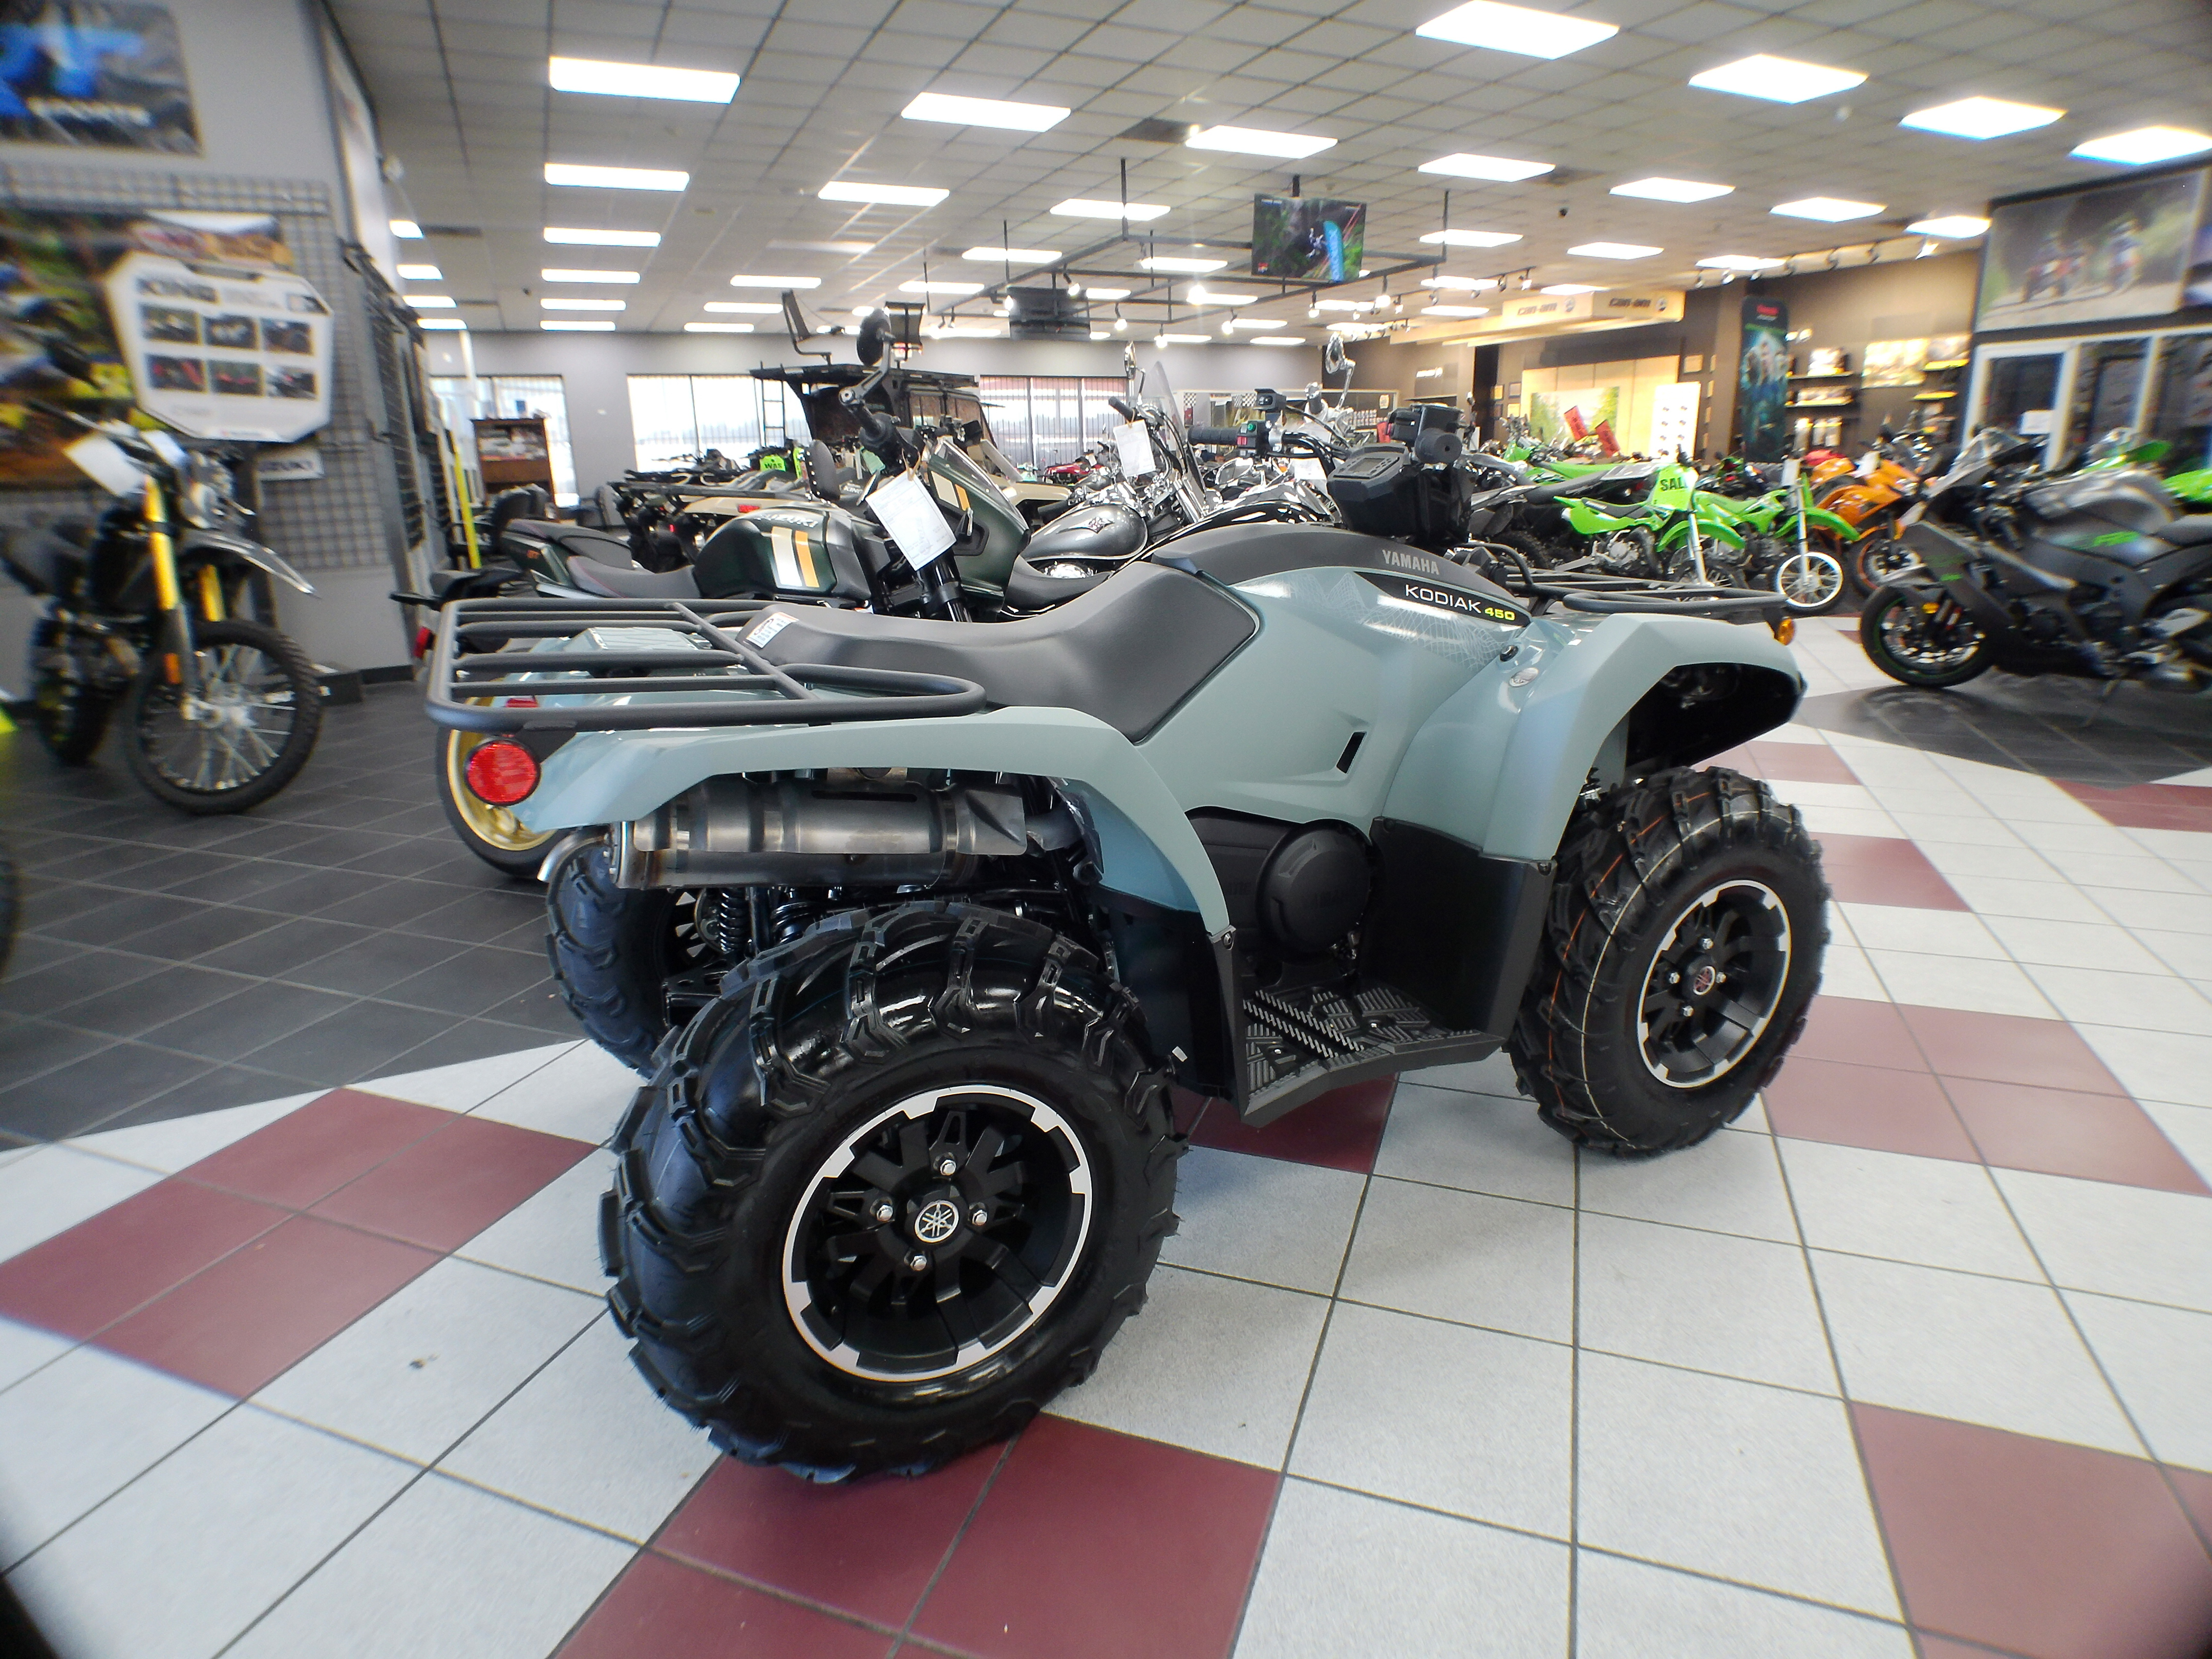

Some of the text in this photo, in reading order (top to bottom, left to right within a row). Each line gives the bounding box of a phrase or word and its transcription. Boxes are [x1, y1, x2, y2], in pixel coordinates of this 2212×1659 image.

[1382, 549, 1439, 575] YAMAHA
[1406, 584, 1515, 621] KODIAK 450
